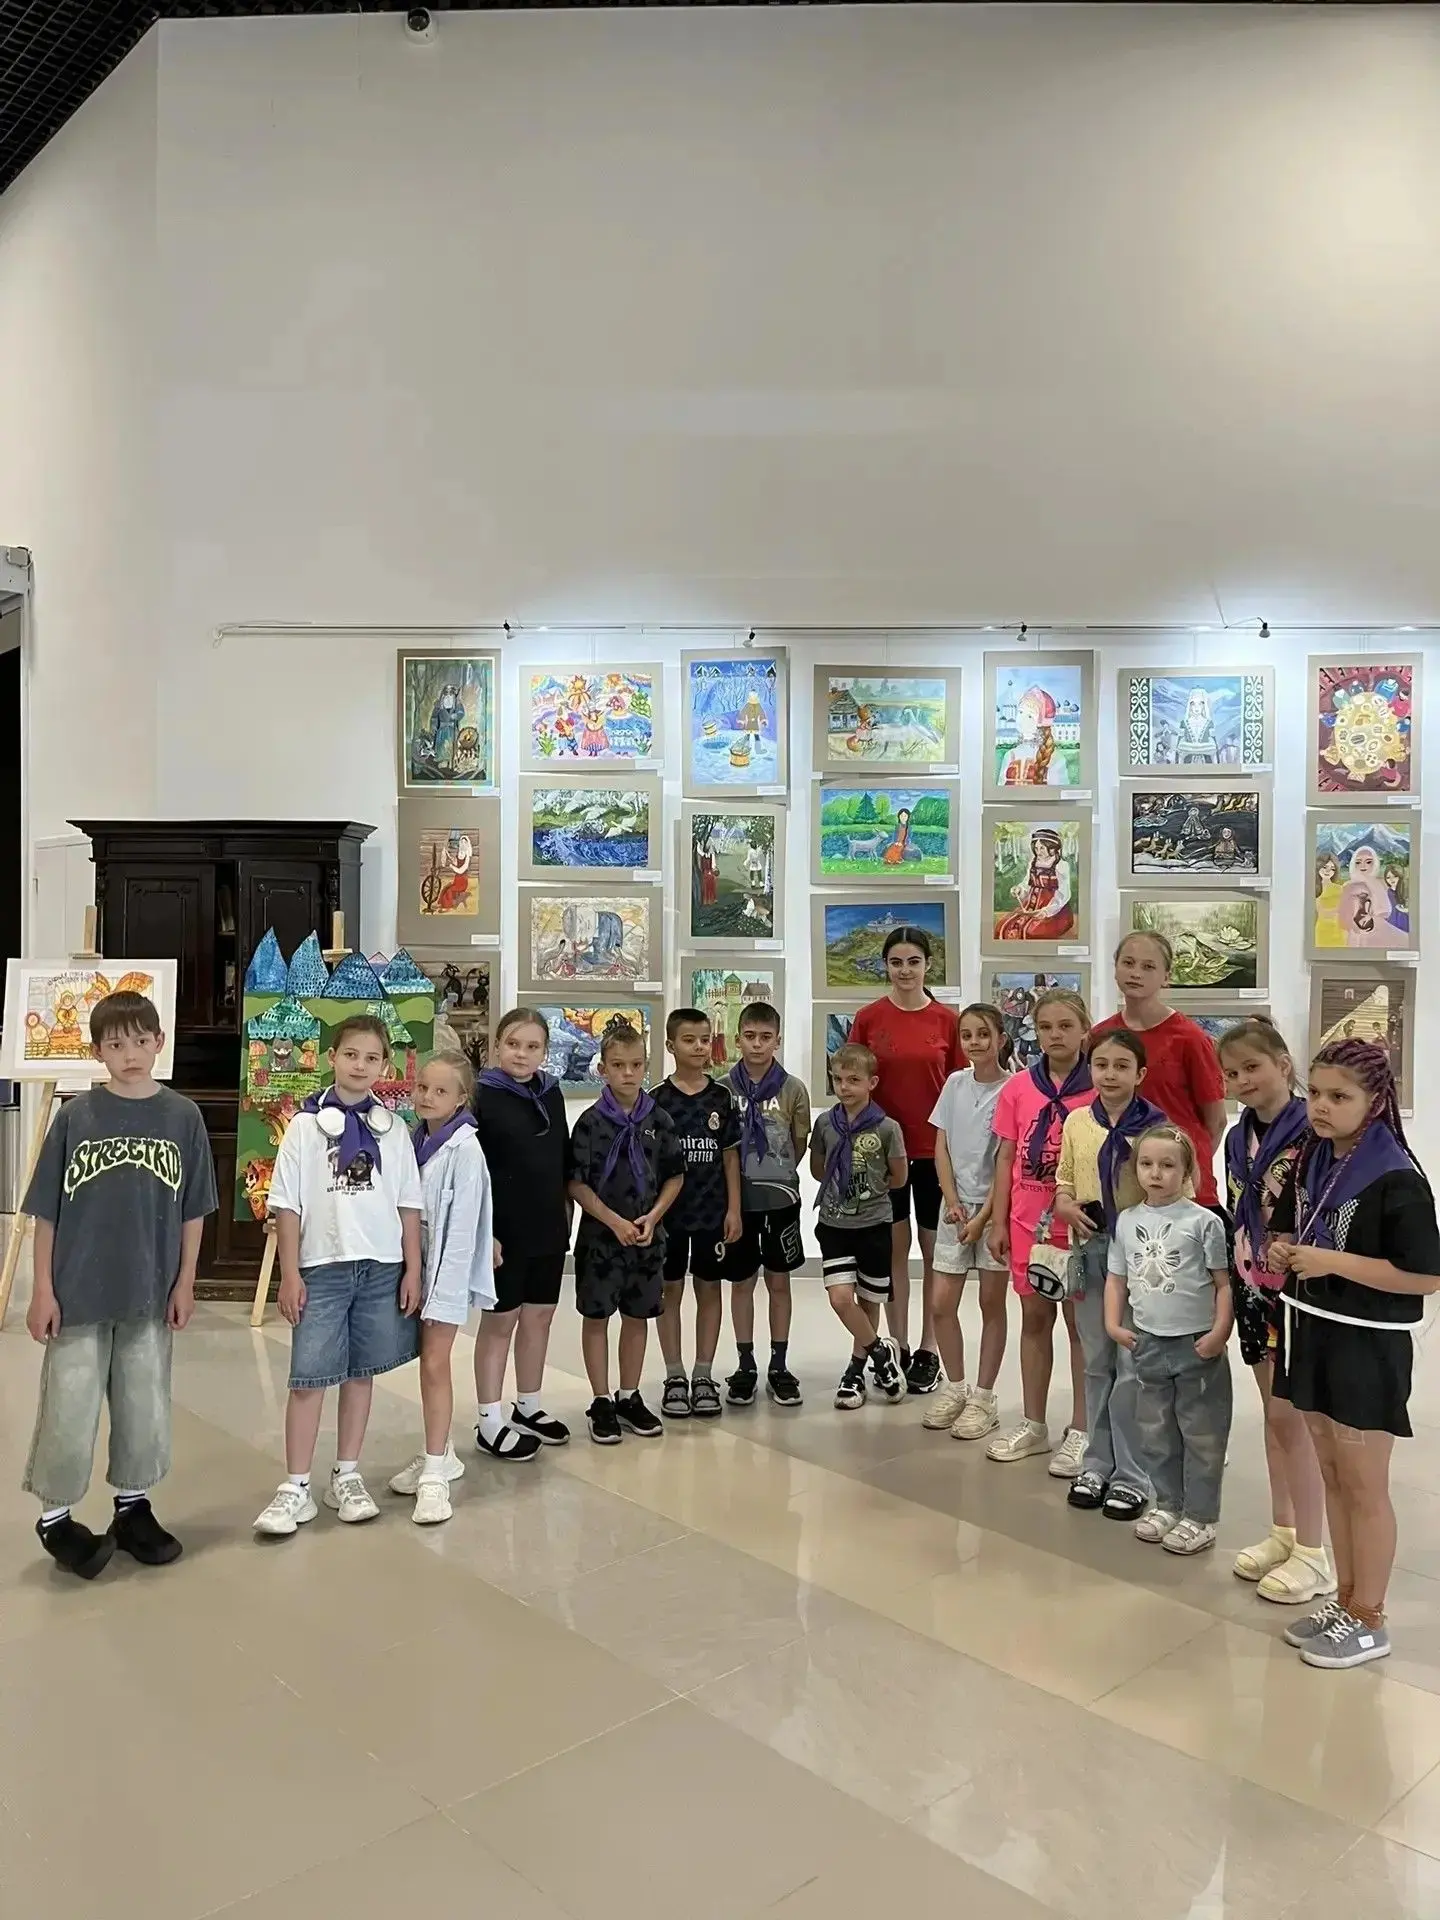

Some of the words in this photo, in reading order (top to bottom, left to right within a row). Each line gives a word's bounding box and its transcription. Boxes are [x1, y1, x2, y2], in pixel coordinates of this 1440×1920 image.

[679, 1135, 719, 1150] mirates
[687, 1150, 714, 1163] BETTER
[714, 1241, 726, 1263] 9
